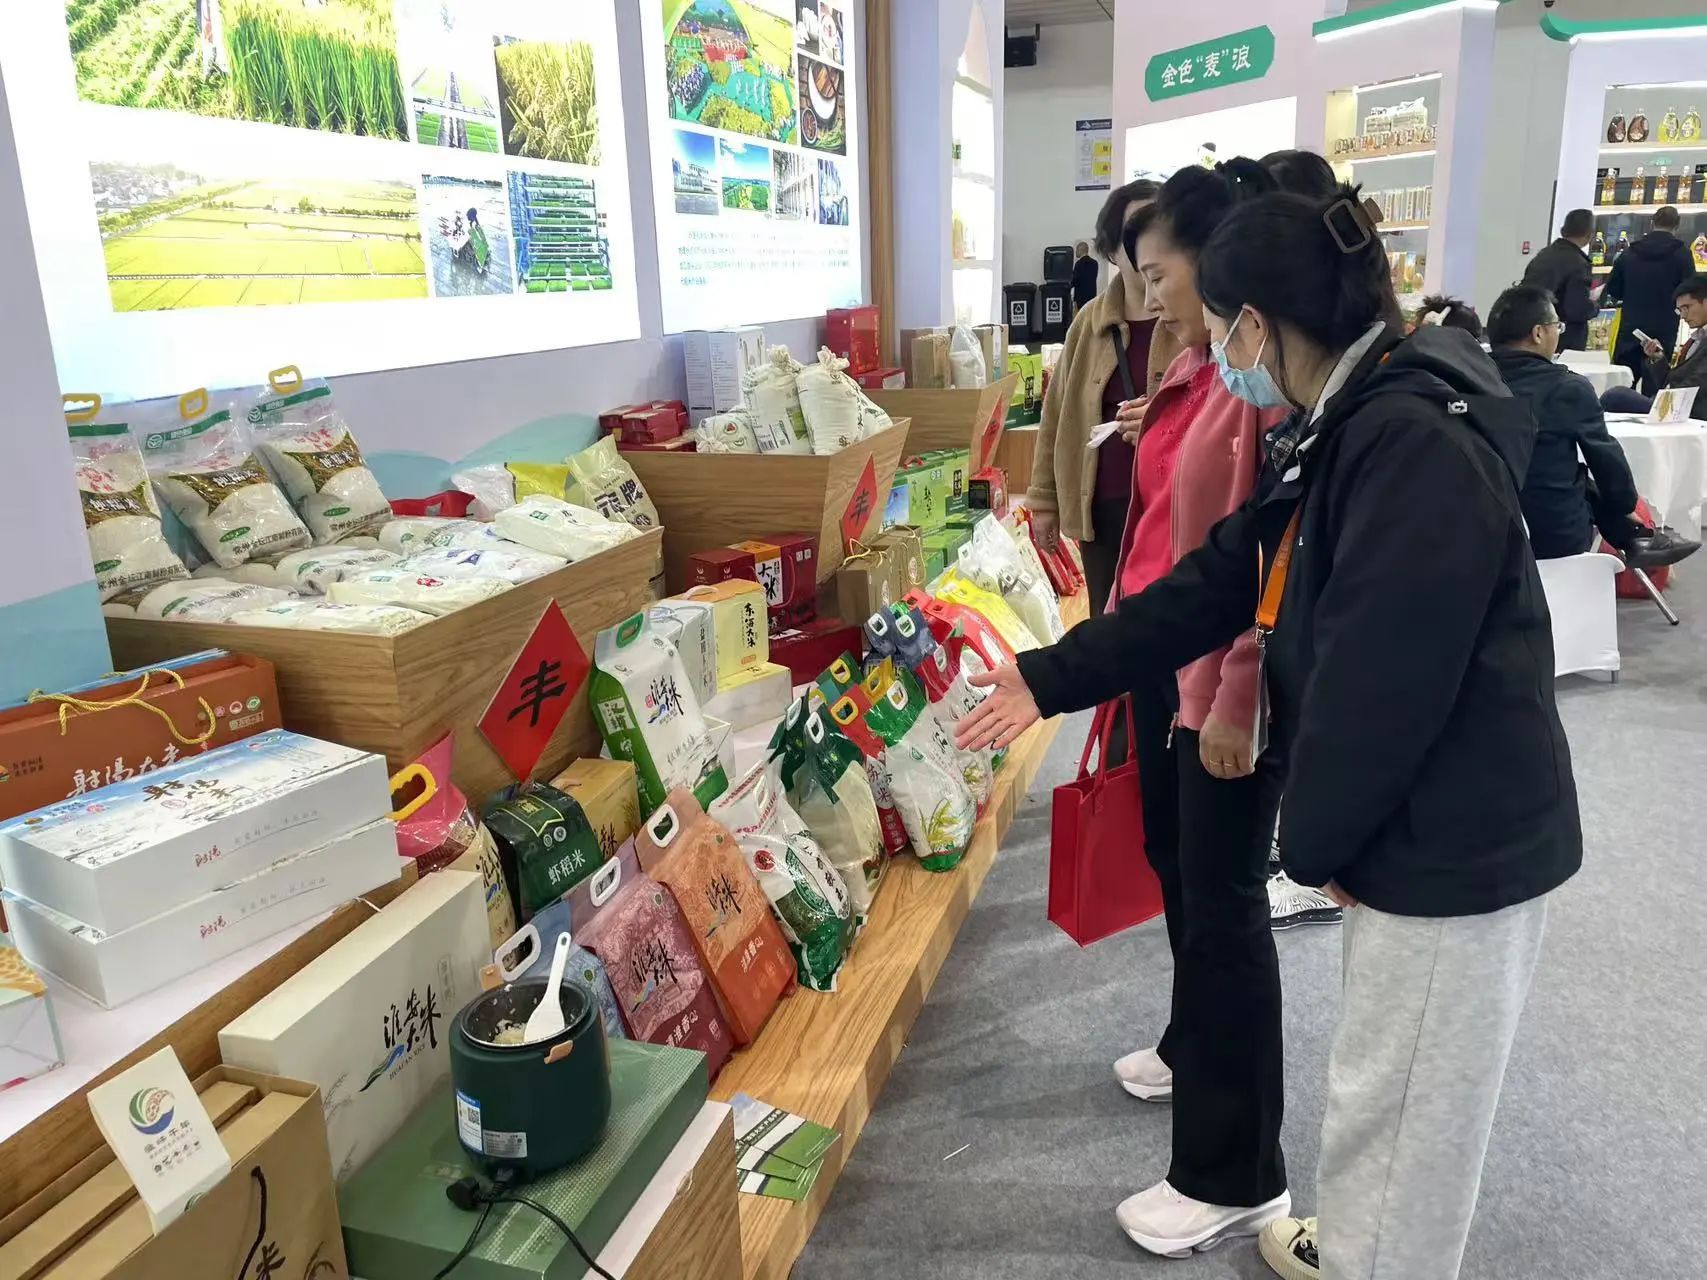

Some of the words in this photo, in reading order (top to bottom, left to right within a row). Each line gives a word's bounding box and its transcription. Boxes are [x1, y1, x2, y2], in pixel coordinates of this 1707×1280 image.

[507, 659, 568, 728] 丰
[547, 848, 587, 886] 虾稻米
